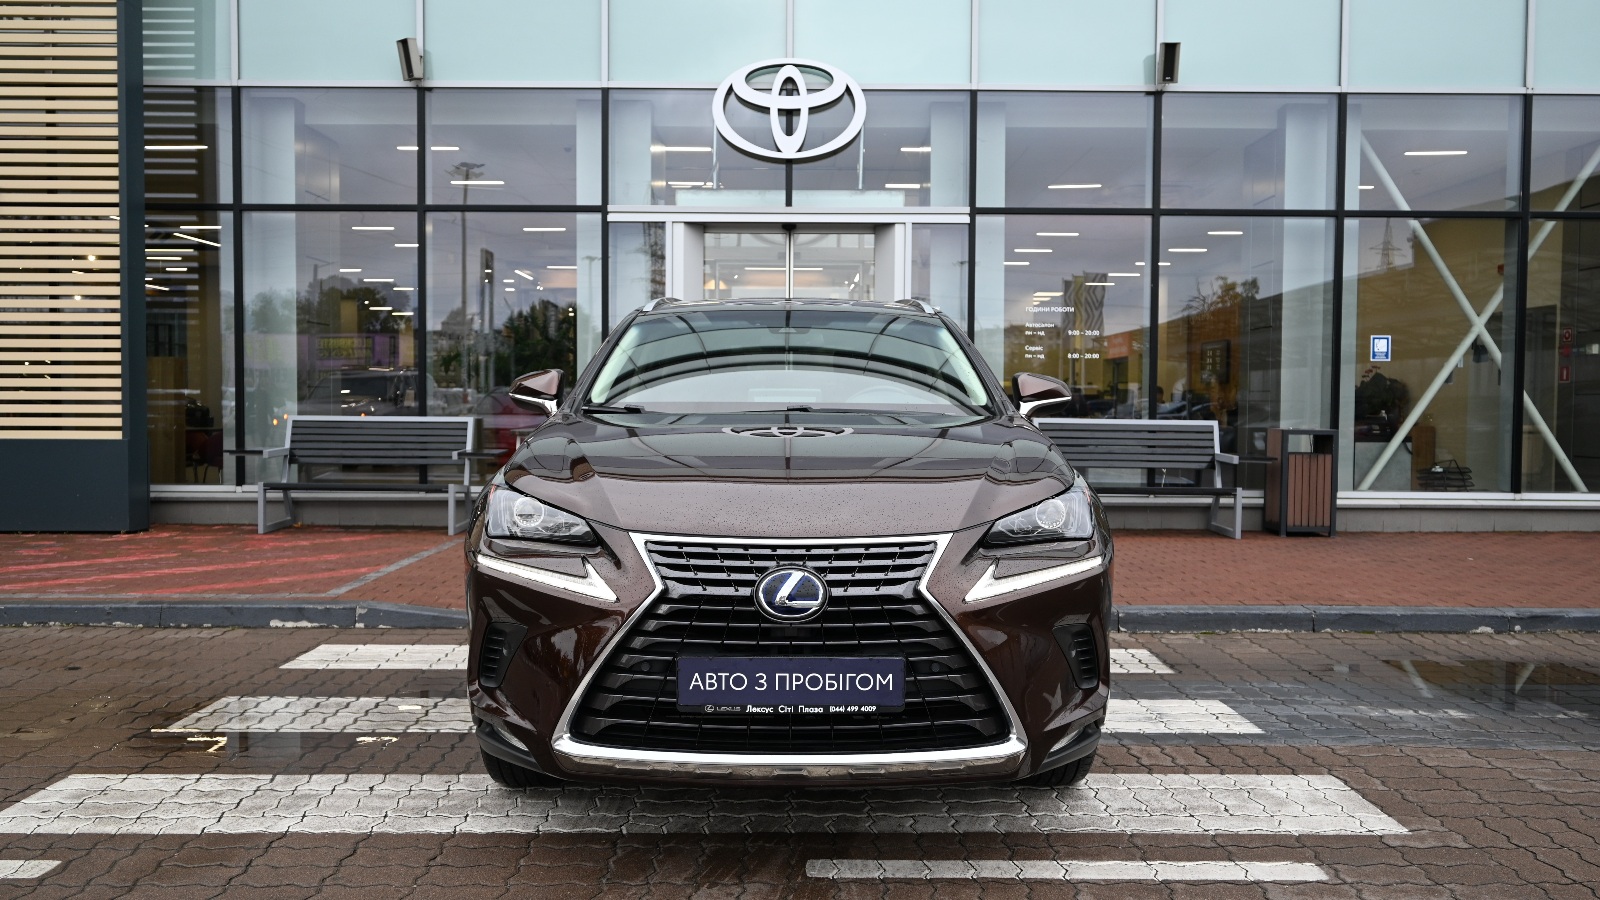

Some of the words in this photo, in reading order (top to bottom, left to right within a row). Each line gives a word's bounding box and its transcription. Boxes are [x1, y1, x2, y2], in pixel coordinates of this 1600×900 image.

[690, 673, 748, 691] АВТО
[775, 673, 893, 691] ПРОБІГОМ
[745, 705, 774, 714] Лексус
[798, 705, 824, 714] Плаза
[829, 705, 846, 713] (044)
